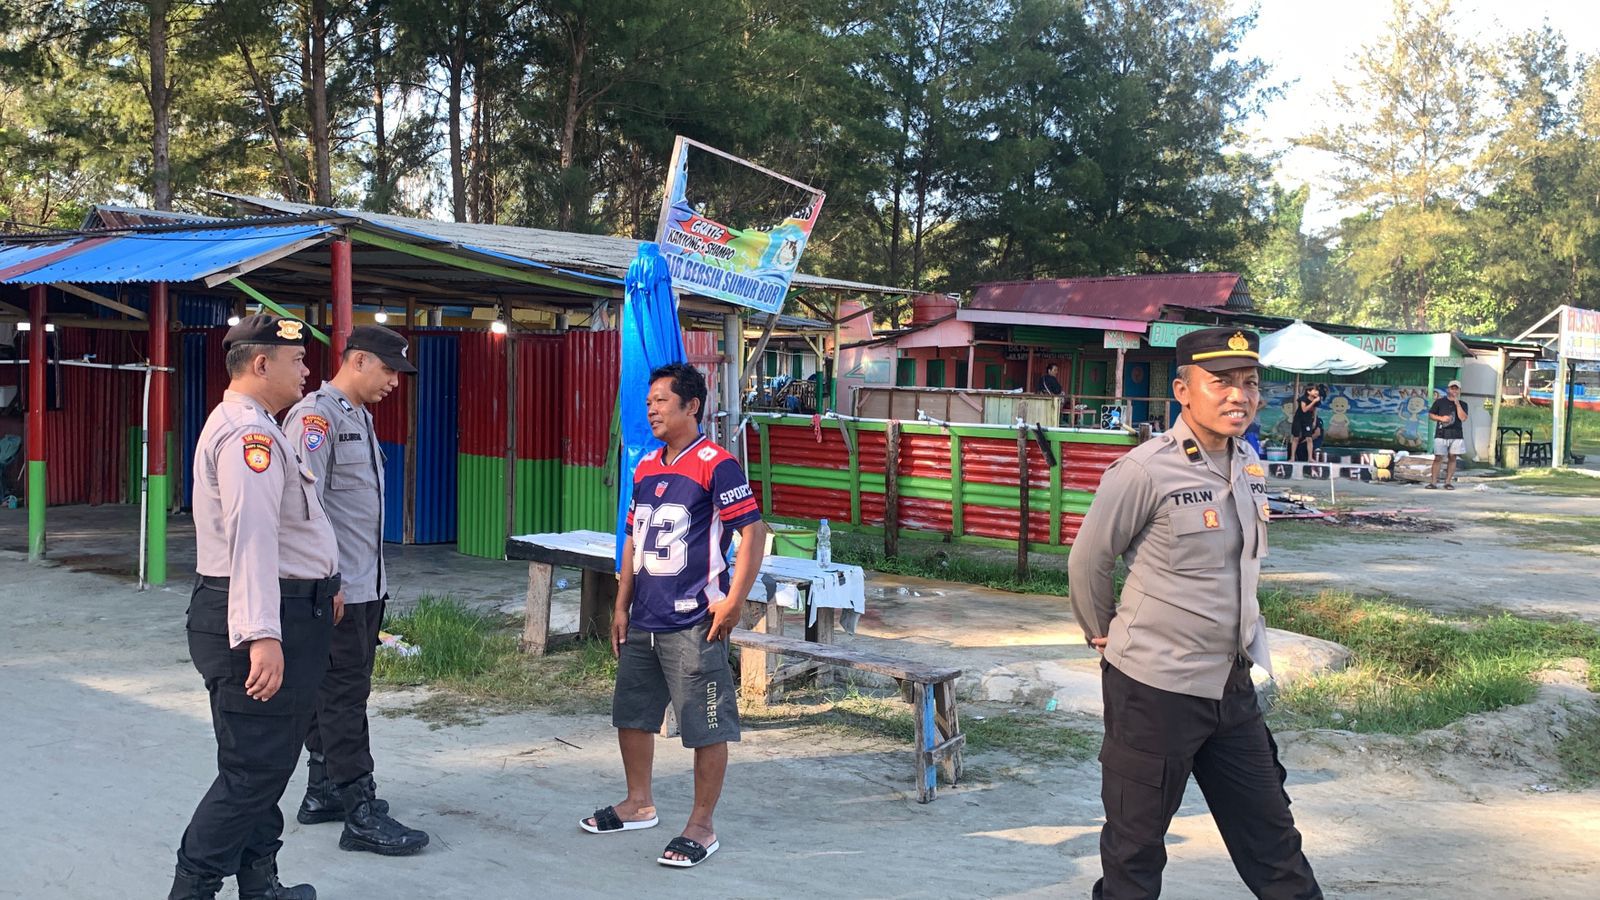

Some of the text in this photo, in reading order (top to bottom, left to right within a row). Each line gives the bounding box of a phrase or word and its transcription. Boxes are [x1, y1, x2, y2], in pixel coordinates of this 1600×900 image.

[667, 229, 703, 251] KANTONG
[705, 242, 735, 260] SHAMPO
[691, 220, 725, 239] GRATIS
[682, 260, 724, 290] BERSIH
[721, 270, 760, 299] SUMUR
[758, 281, 780, 305] BOR
[1170, 490, 1213, 506] TRI.W
[632, 503, 692, 577] 93
[706, 681, 719, 730] CONVERSE
